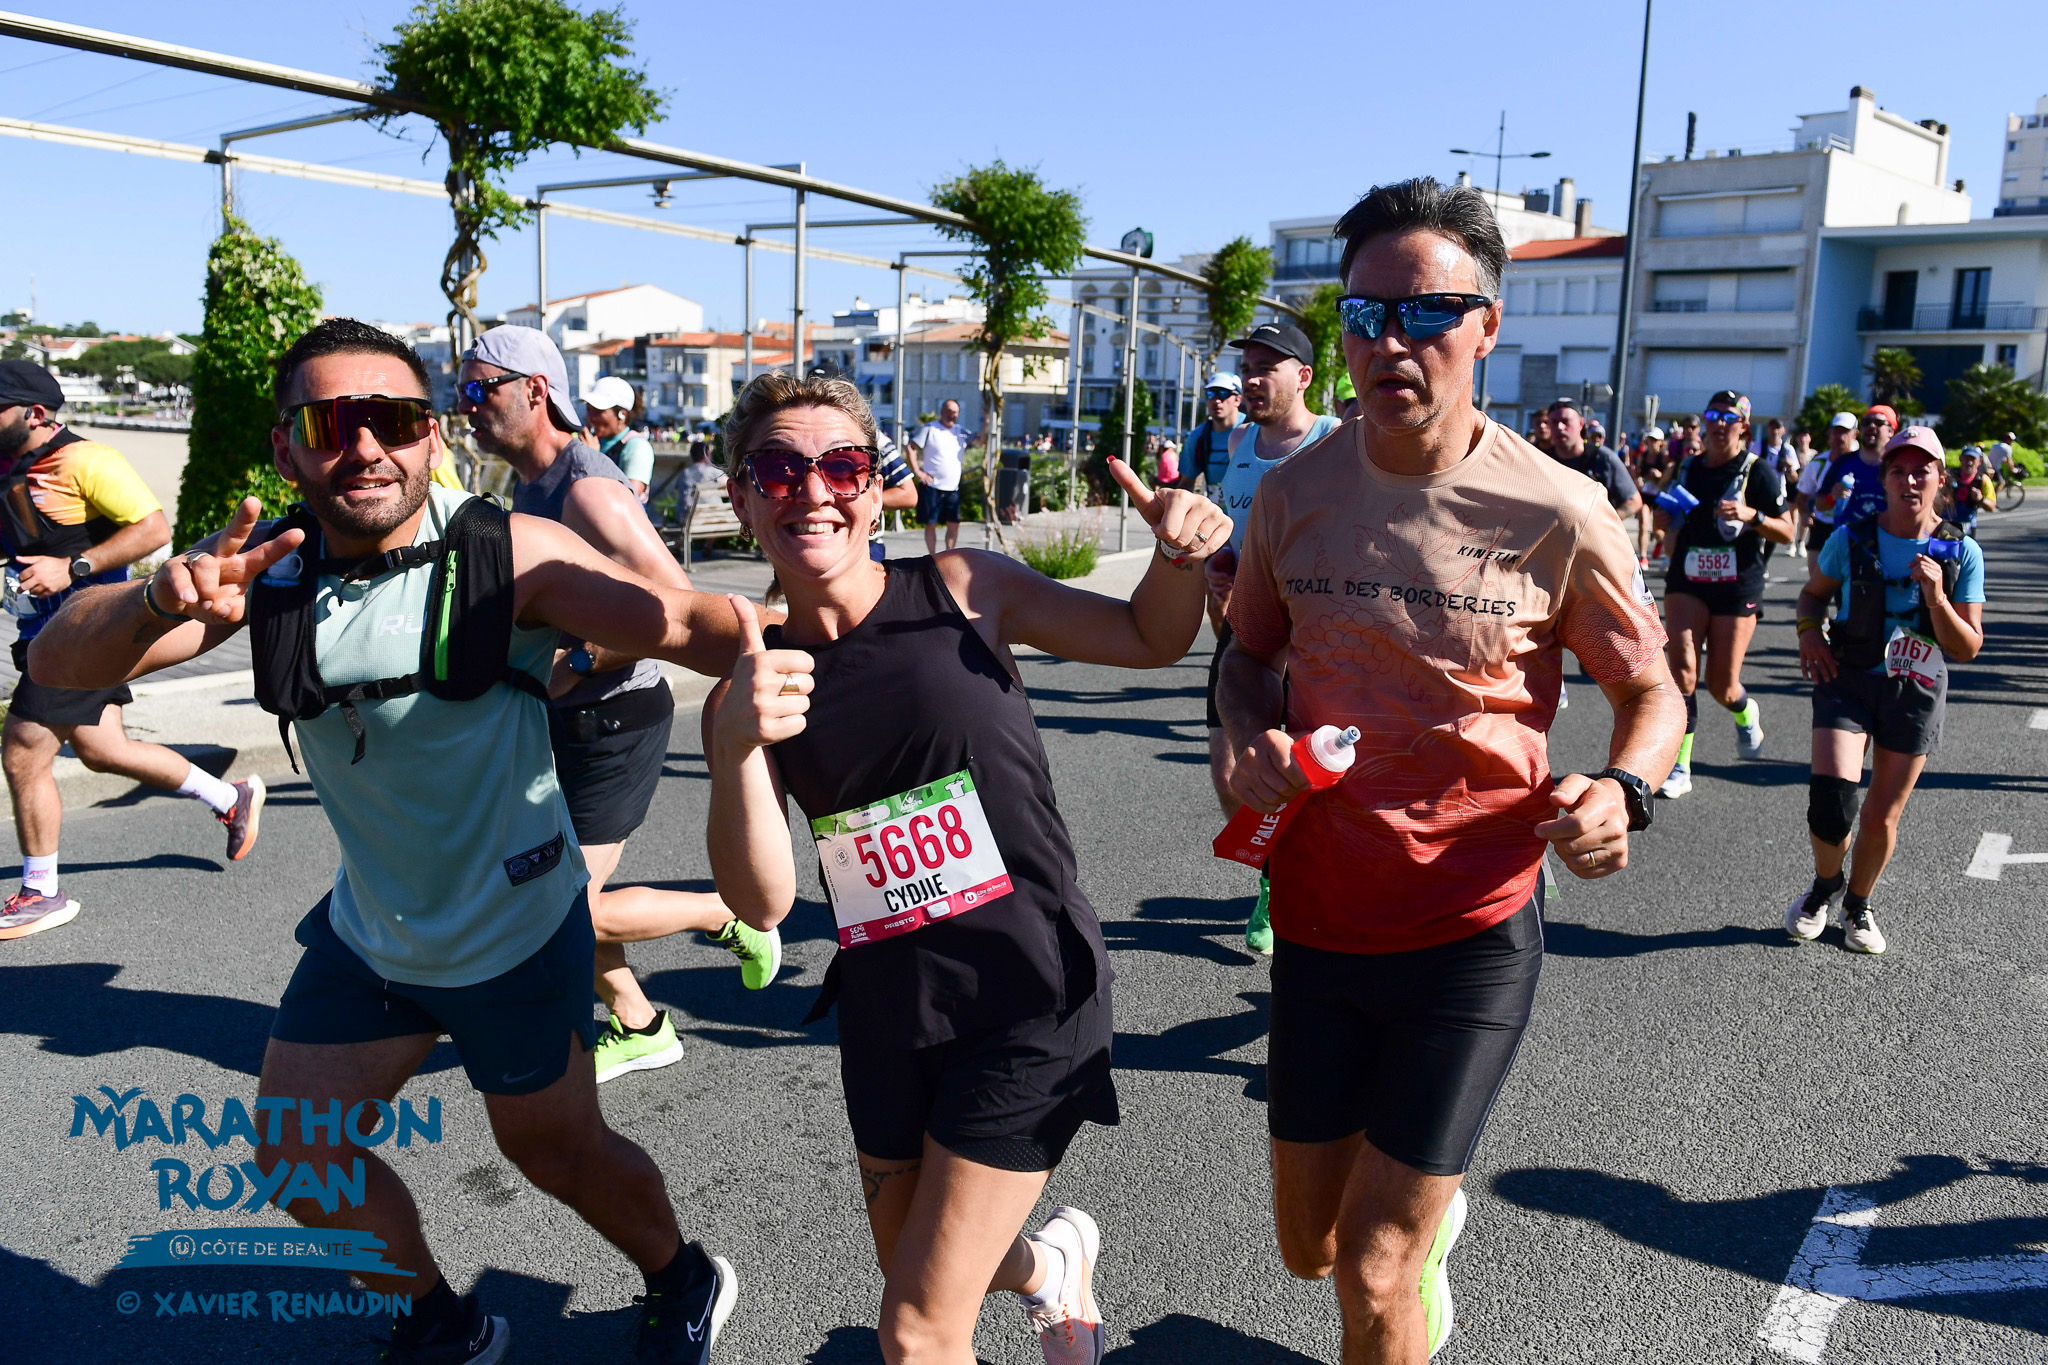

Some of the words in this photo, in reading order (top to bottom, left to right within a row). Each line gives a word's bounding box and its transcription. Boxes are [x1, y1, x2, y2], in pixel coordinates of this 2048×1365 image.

[1457, 545, 1522, 564] KINETIK
[1697, 553, 1730, 570] 5582
[1286, 578, 1334, 595] TRAIL
[1345, 580, 1381, 598] DES
[1389, 585, 1517, 617] BORDERIES
[1892, 636, 1933, 663] 5167
[1890, 658, 1915, 670] CHLOE
[853, 804, 972, 888] 5668
[883, 873, 948, 913] CYDJIE
[884, 916, 916, 930] PRESTO
